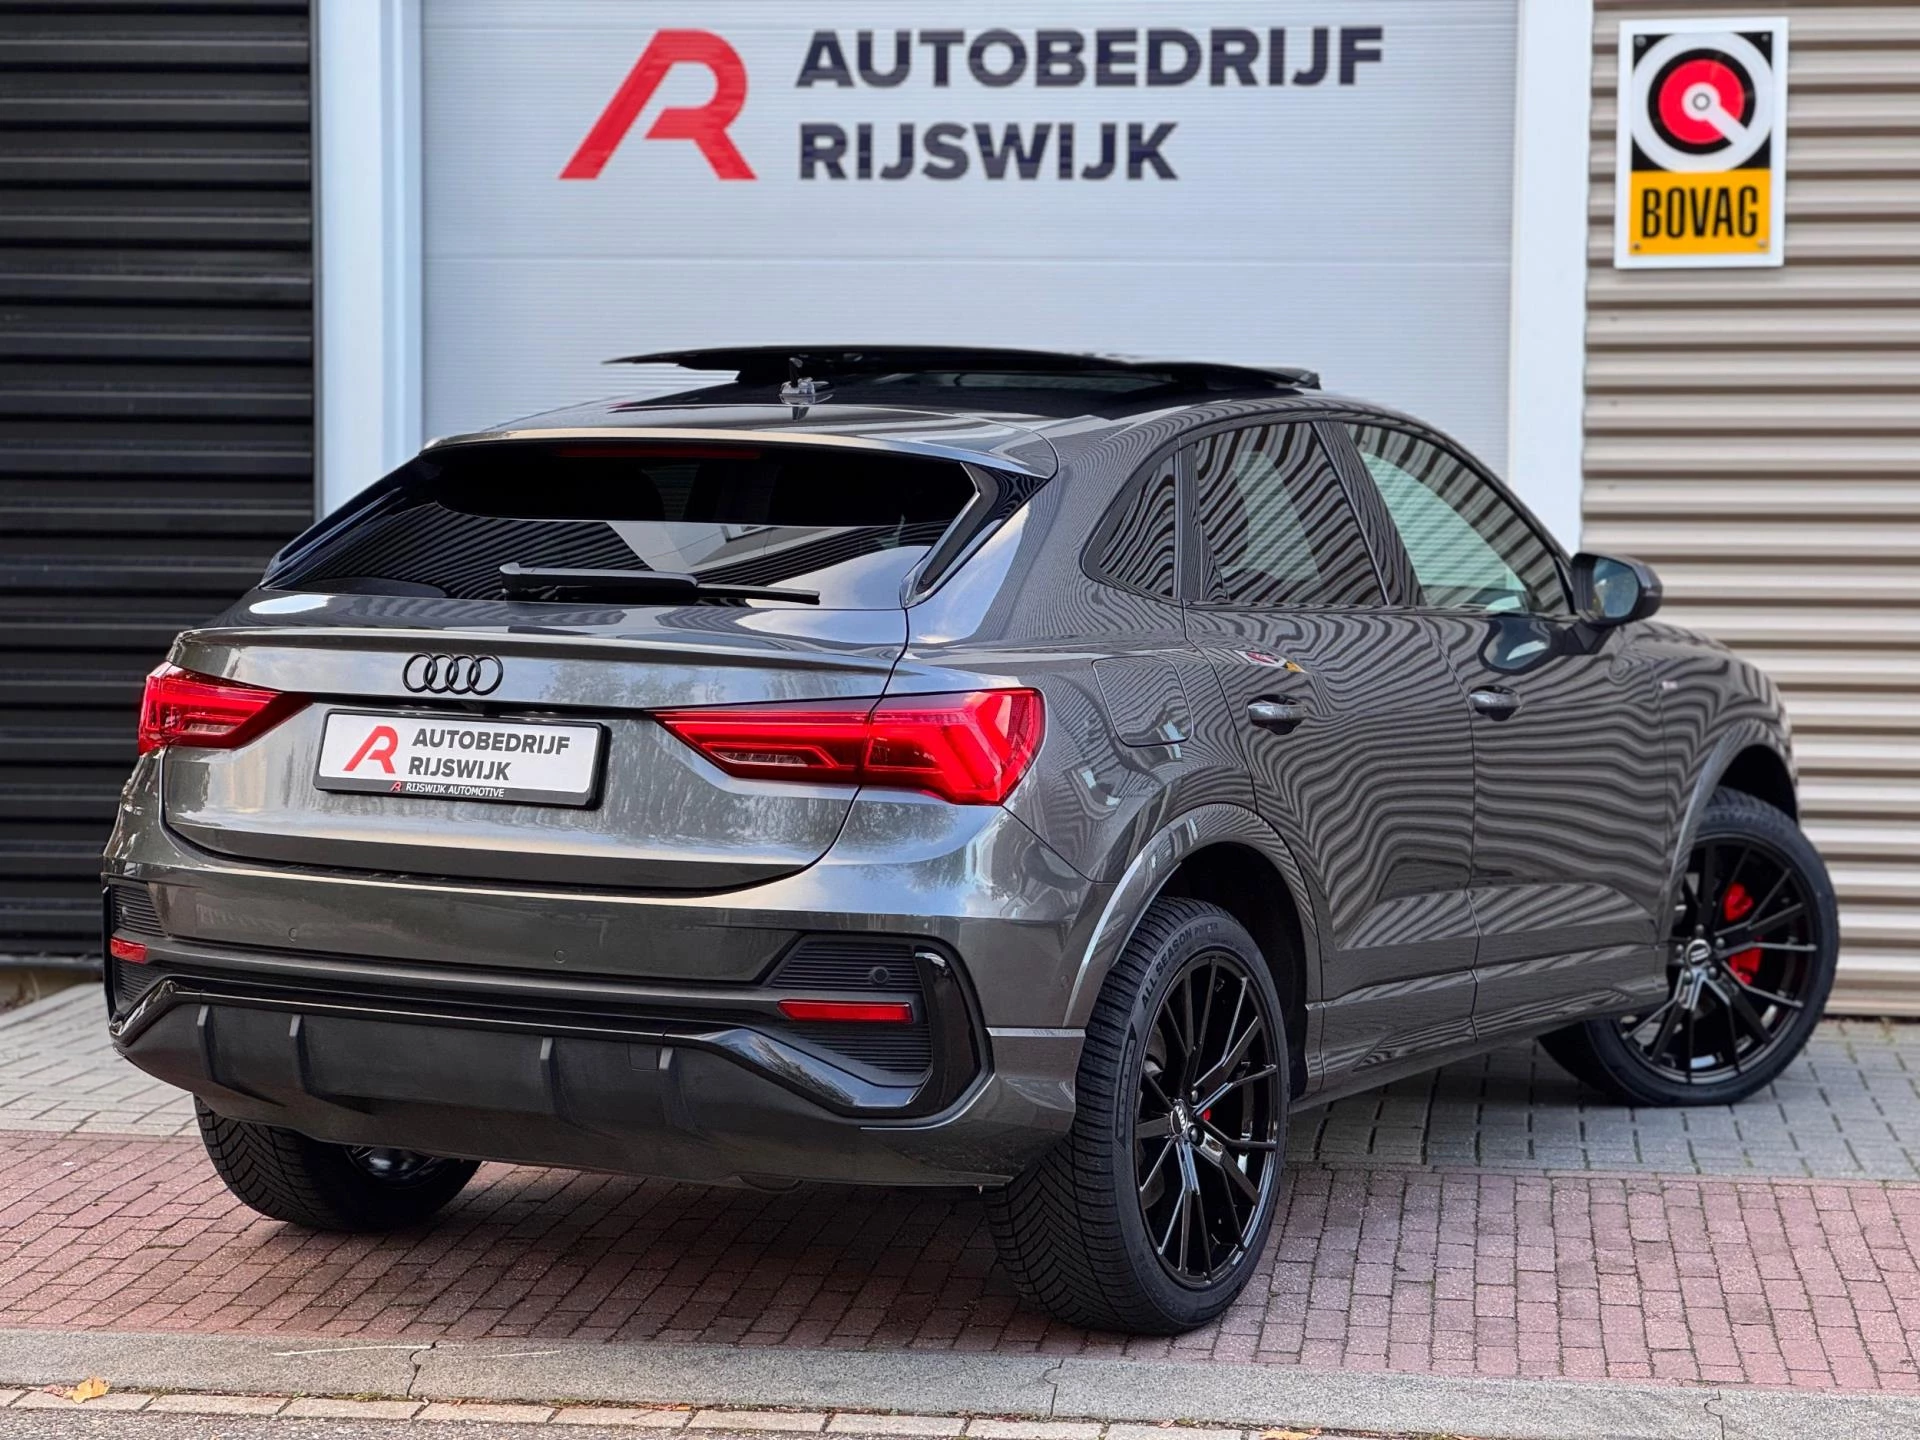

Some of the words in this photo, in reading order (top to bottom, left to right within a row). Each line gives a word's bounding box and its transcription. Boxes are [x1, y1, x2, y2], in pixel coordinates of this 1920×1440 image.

[796, 26, 1383, 88] AUTOBEDRIJF
[800, 123, 1179, 181] RIJSWIJK
[1641, 185, 1759, 239] BOVAG
[408, 756, 512, 780] RIJSWIJK
[412, 728, 570, 755] AUTOBEDRIJF
[405, 782, 446, 794] RIJSWIJK
[448, 785, 505, 797] AUTOMOTIVE
[1141, 978, 1157, 1009] ALL
[1155, 927, 1193, 976] SEASON
